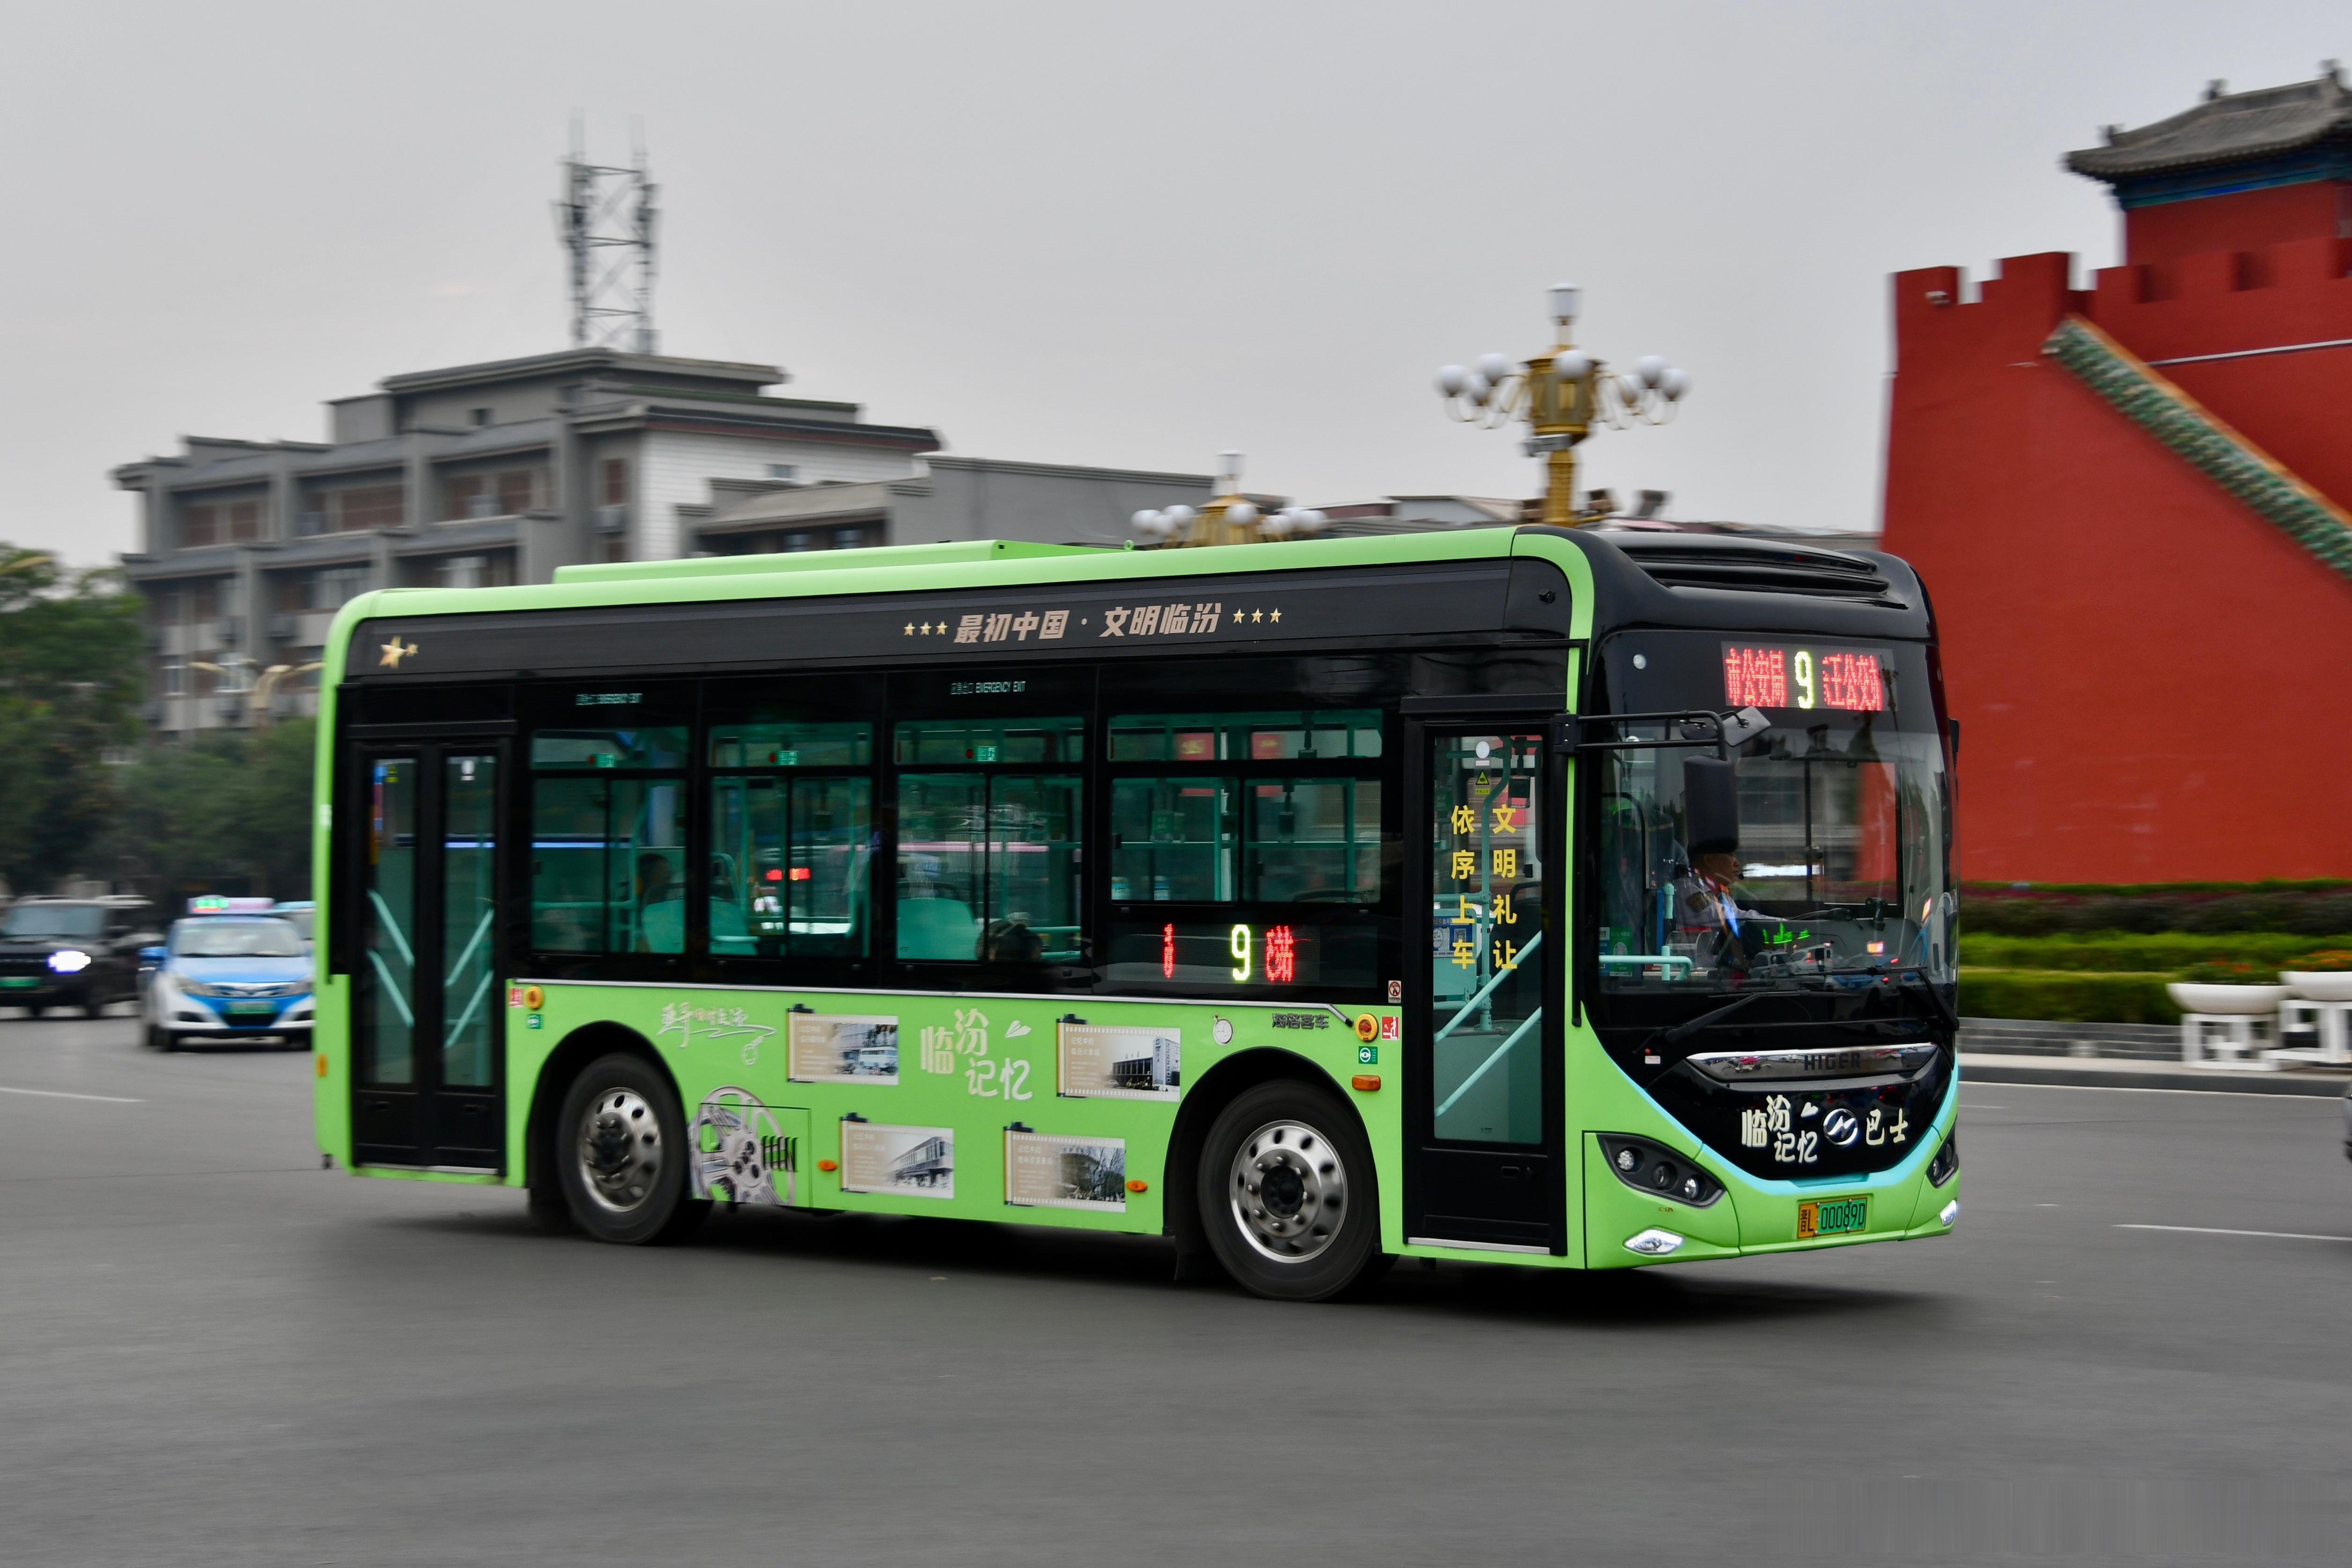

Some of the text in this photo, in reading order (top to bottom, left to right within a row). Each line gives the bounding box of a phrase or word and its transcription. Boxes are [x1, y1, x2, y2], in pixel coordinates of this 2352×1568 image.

[975, 681, 1012, 693] EMERGENCY
[1013, 681, 1026, 692] EXIT
[1794, 651, 1814, 709] 9
[1451, 805, 1476, 970] 依序上车
[1492, 803, 1518, 970] 文明礼让
[1231, 924, 1252, 982] 9
[920, 1008, 989, 1074] 临汾
[1272, 1013, 1329, 1029] 海格客车
[965, 1057, 1033, 1101] 记忆
[1804, 1052, 1861, 1071] HIGER
[1741, 1094, 1792, 1148] 临汾
[1865, 1108, 1909, 1146] 巴士
[1774, 1130, 1818, 1163] 记忆
